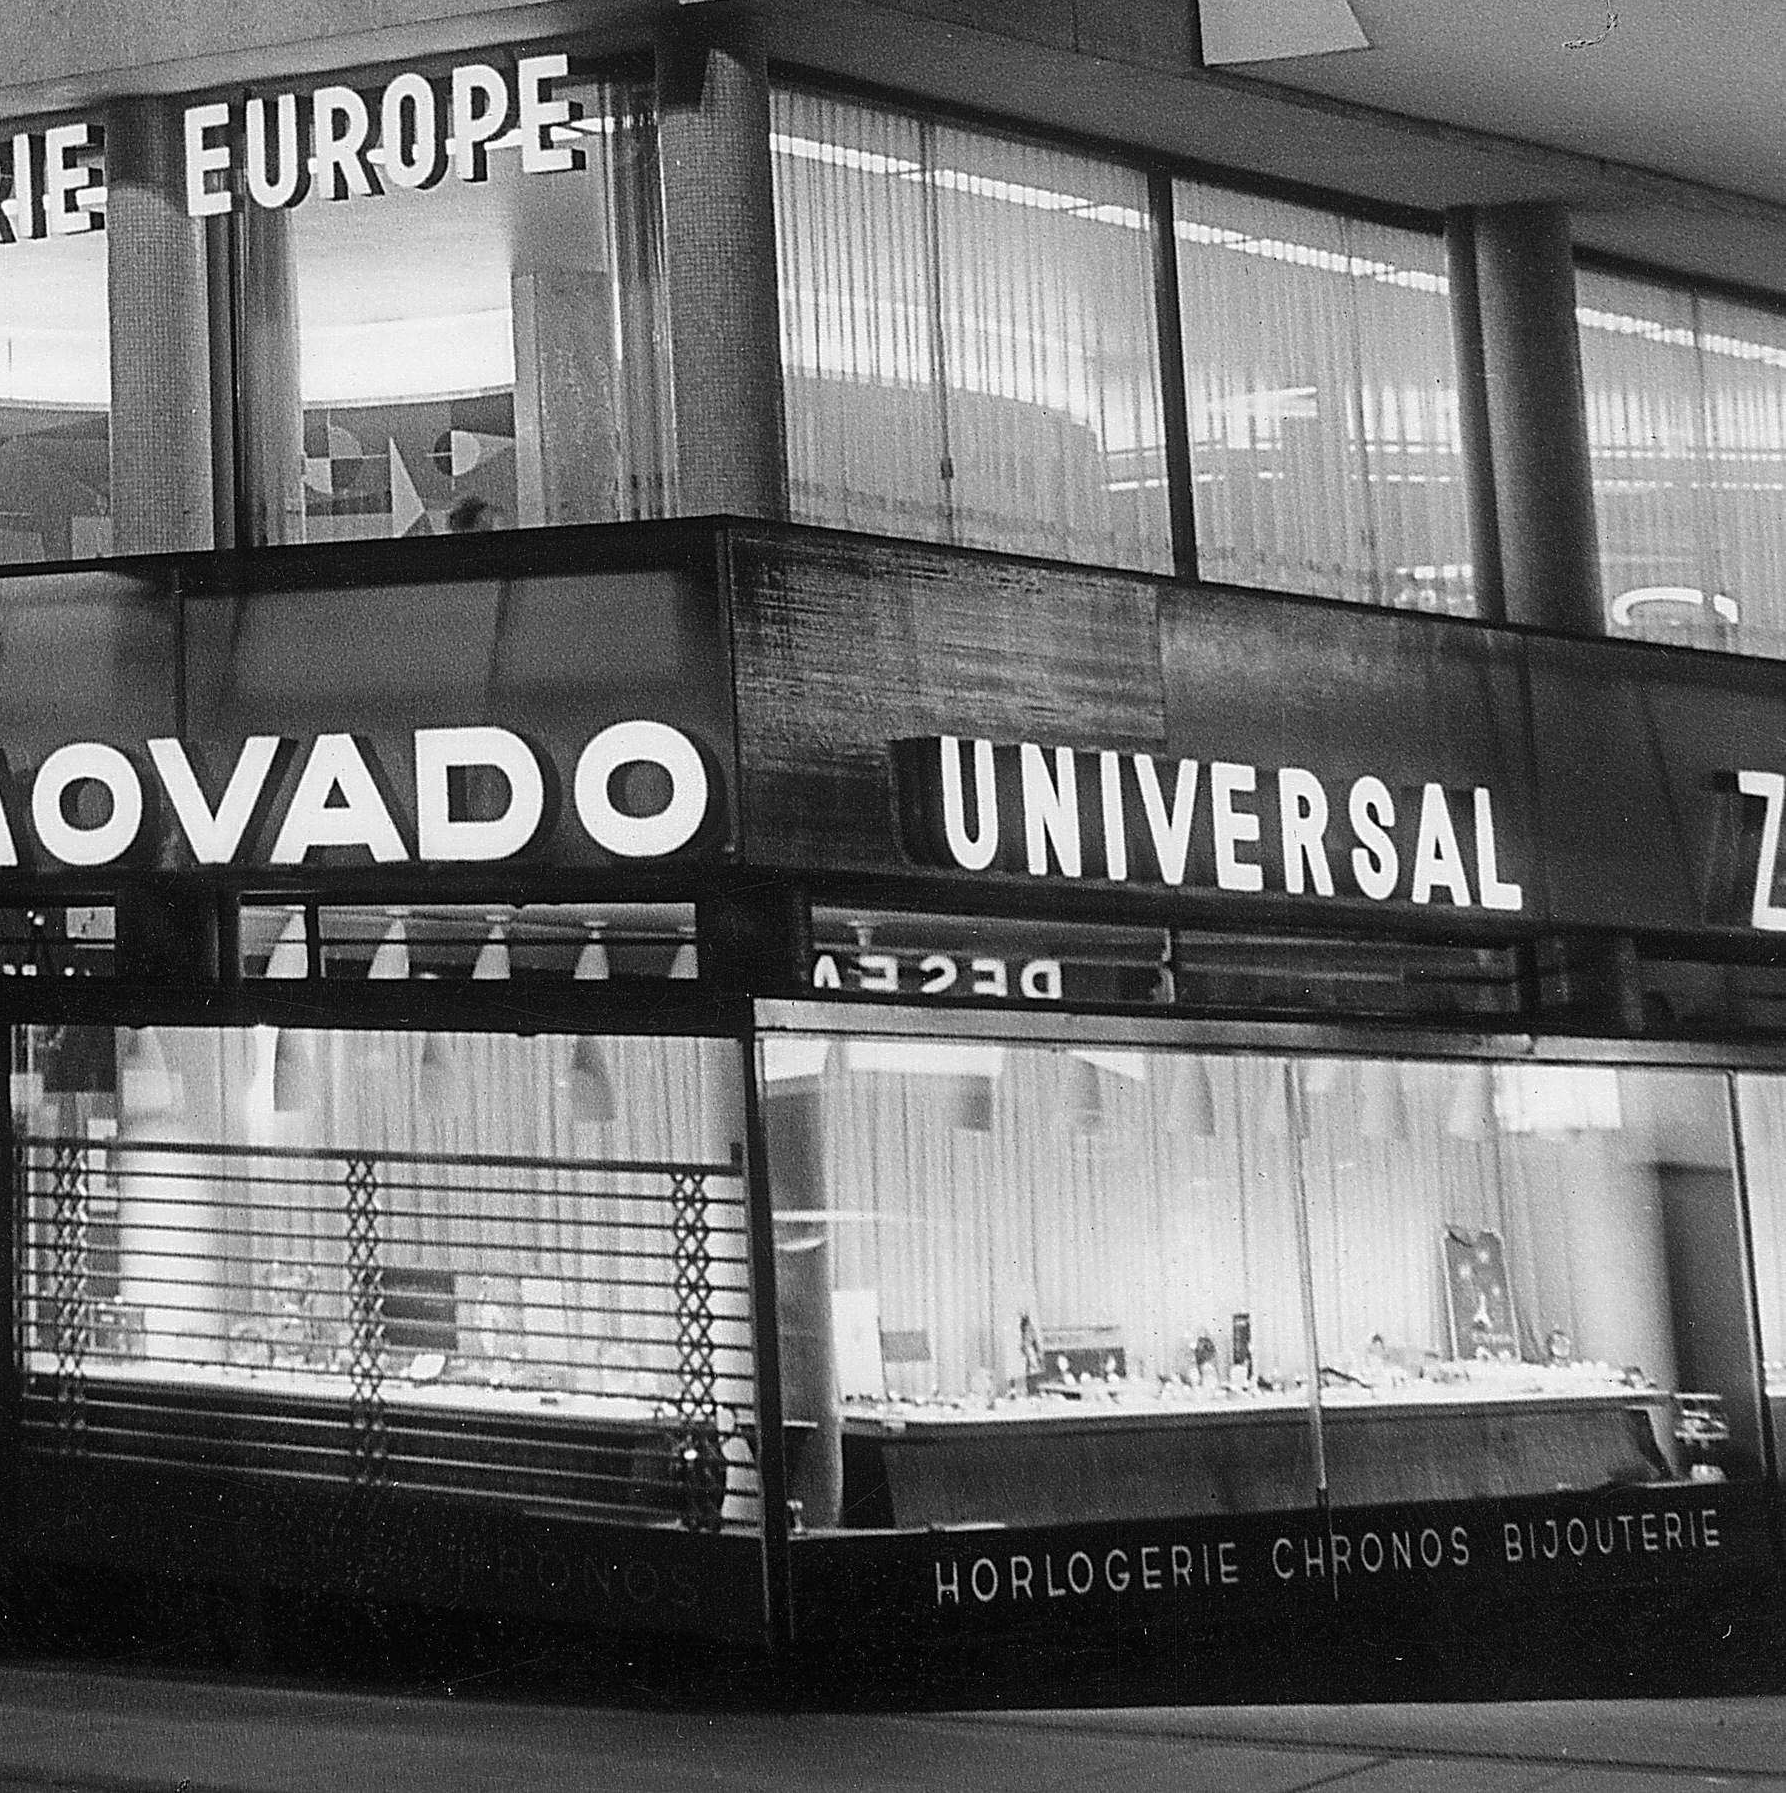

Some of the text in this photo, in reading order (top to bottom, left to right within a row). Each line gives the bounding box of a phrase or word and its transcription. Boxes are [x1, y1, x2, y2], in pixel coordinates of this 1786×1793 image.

[184, 54, 574, 217] EUROPE
[939, 733, 1524, 912] UNIVERSAL
[933, 1506, 1723, 1605] HORLOGERIE CHRONOS BIJOUTERIE
